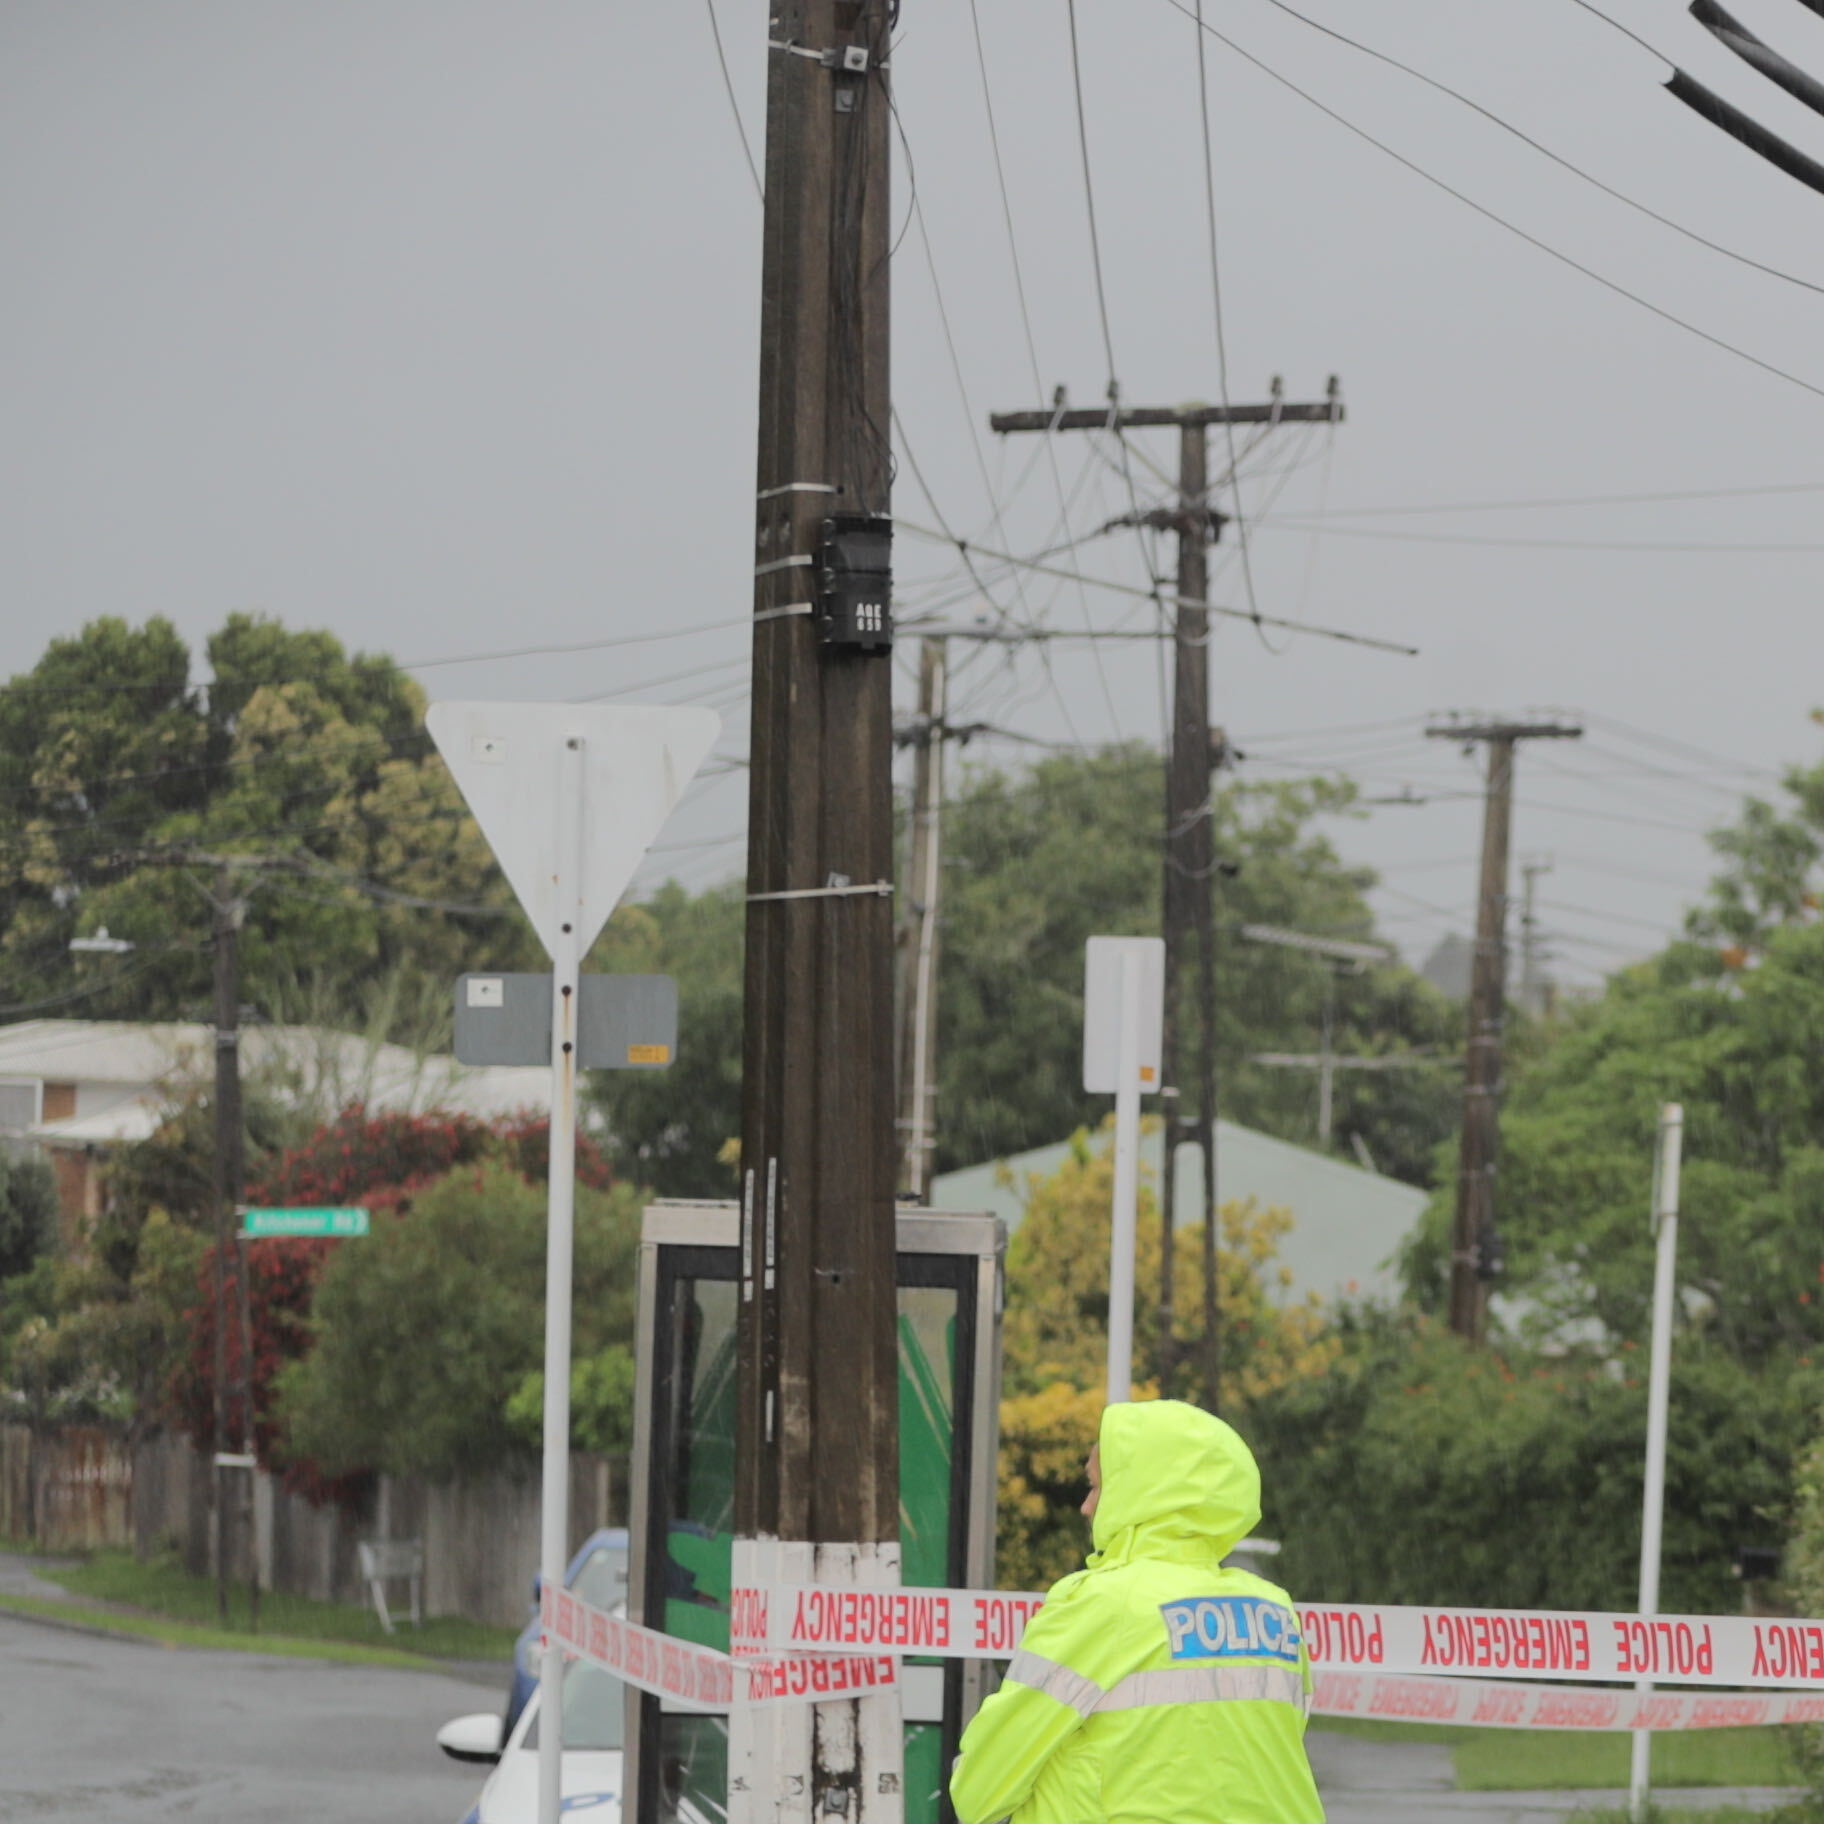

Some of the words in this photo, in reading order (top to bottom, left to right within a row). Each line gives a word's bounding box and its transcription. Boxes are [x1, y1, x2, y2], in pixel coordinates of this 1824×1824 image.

[790, 1591, 950, 1647] EMERGENCY
[1163, 1601, 1299, 1656] POLICE
[1418, 1614, 1591, 1671] EMERGENCY
[1615, 1621, 1713, 1676] POLICE
